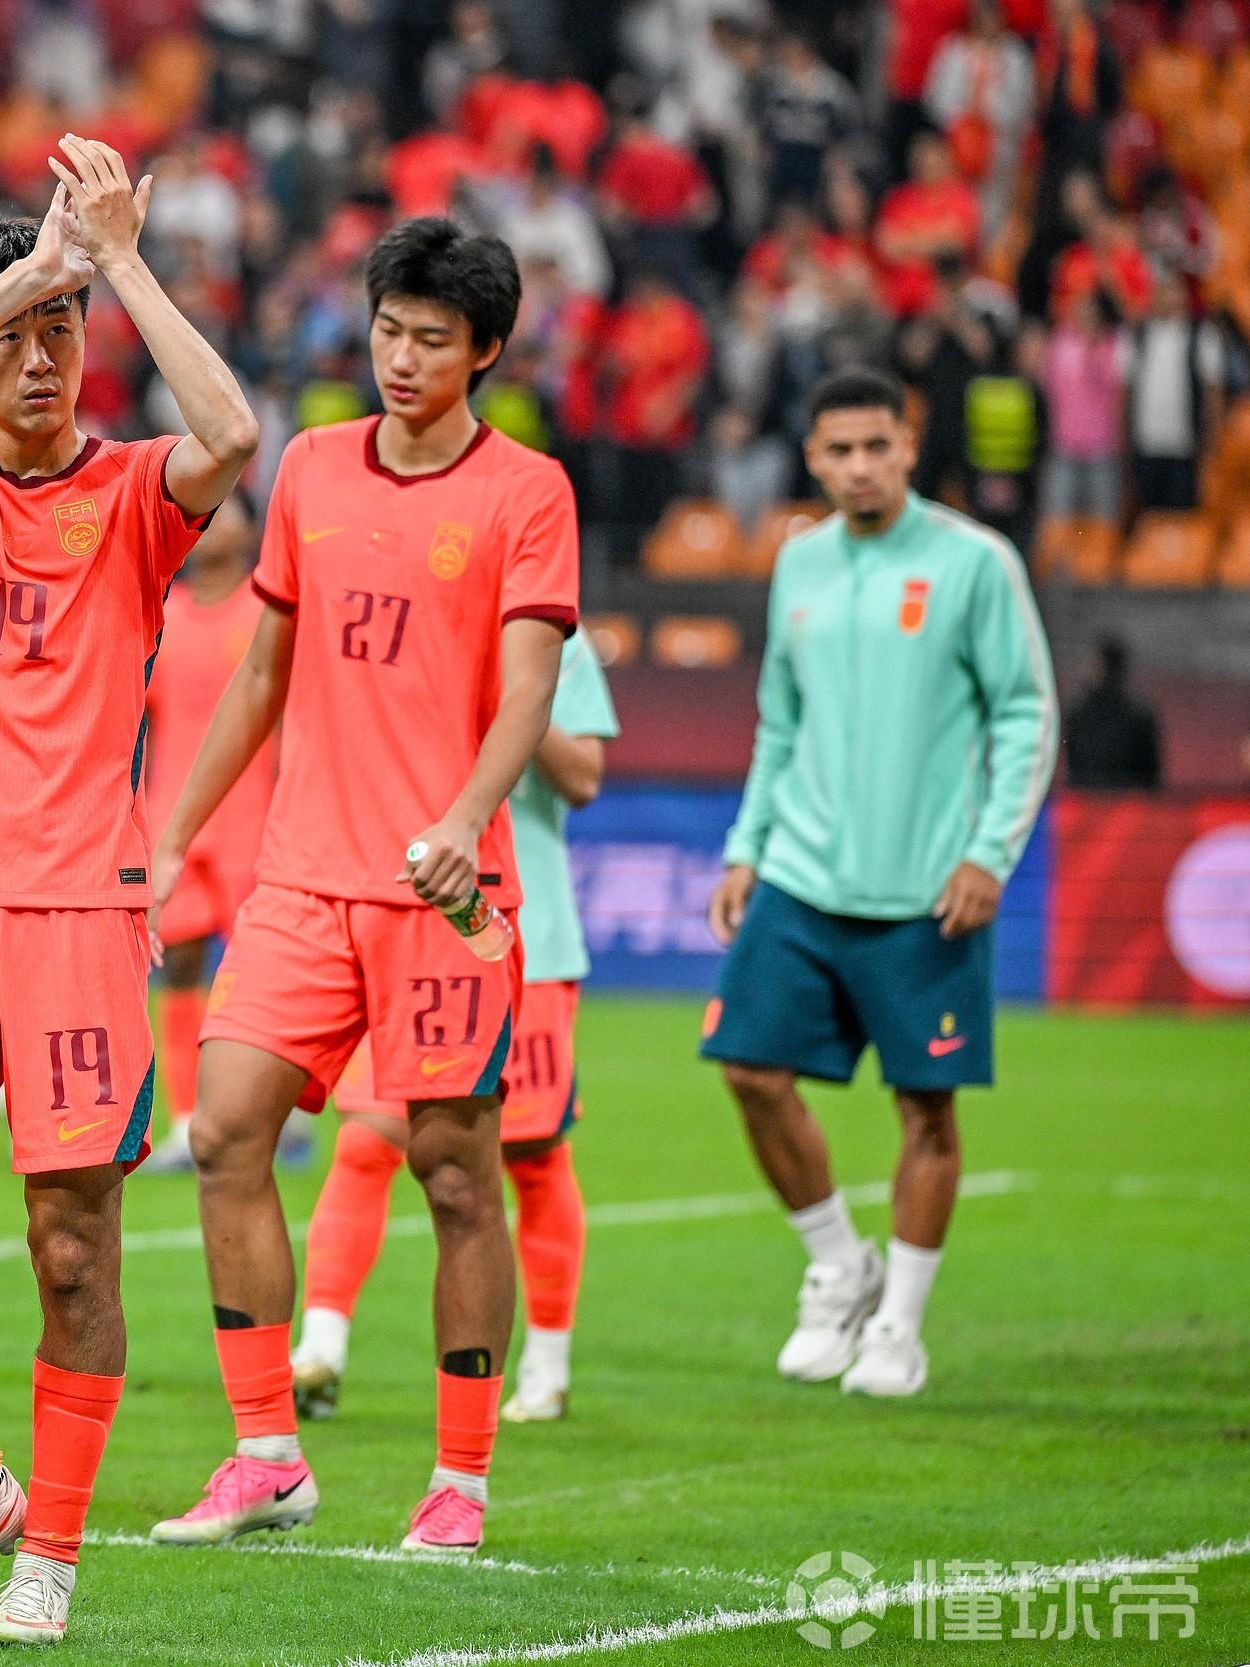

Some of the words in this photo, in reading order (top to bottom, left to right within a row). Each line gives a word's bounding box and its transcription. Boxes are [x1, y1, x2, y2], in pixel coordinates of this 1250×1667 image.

[58, 503, 93, 519] CFA
[341, 588, 411, 668] 27
[408, 975, 482, 1047] 27
[43, 1027, 119, 1111] 19
